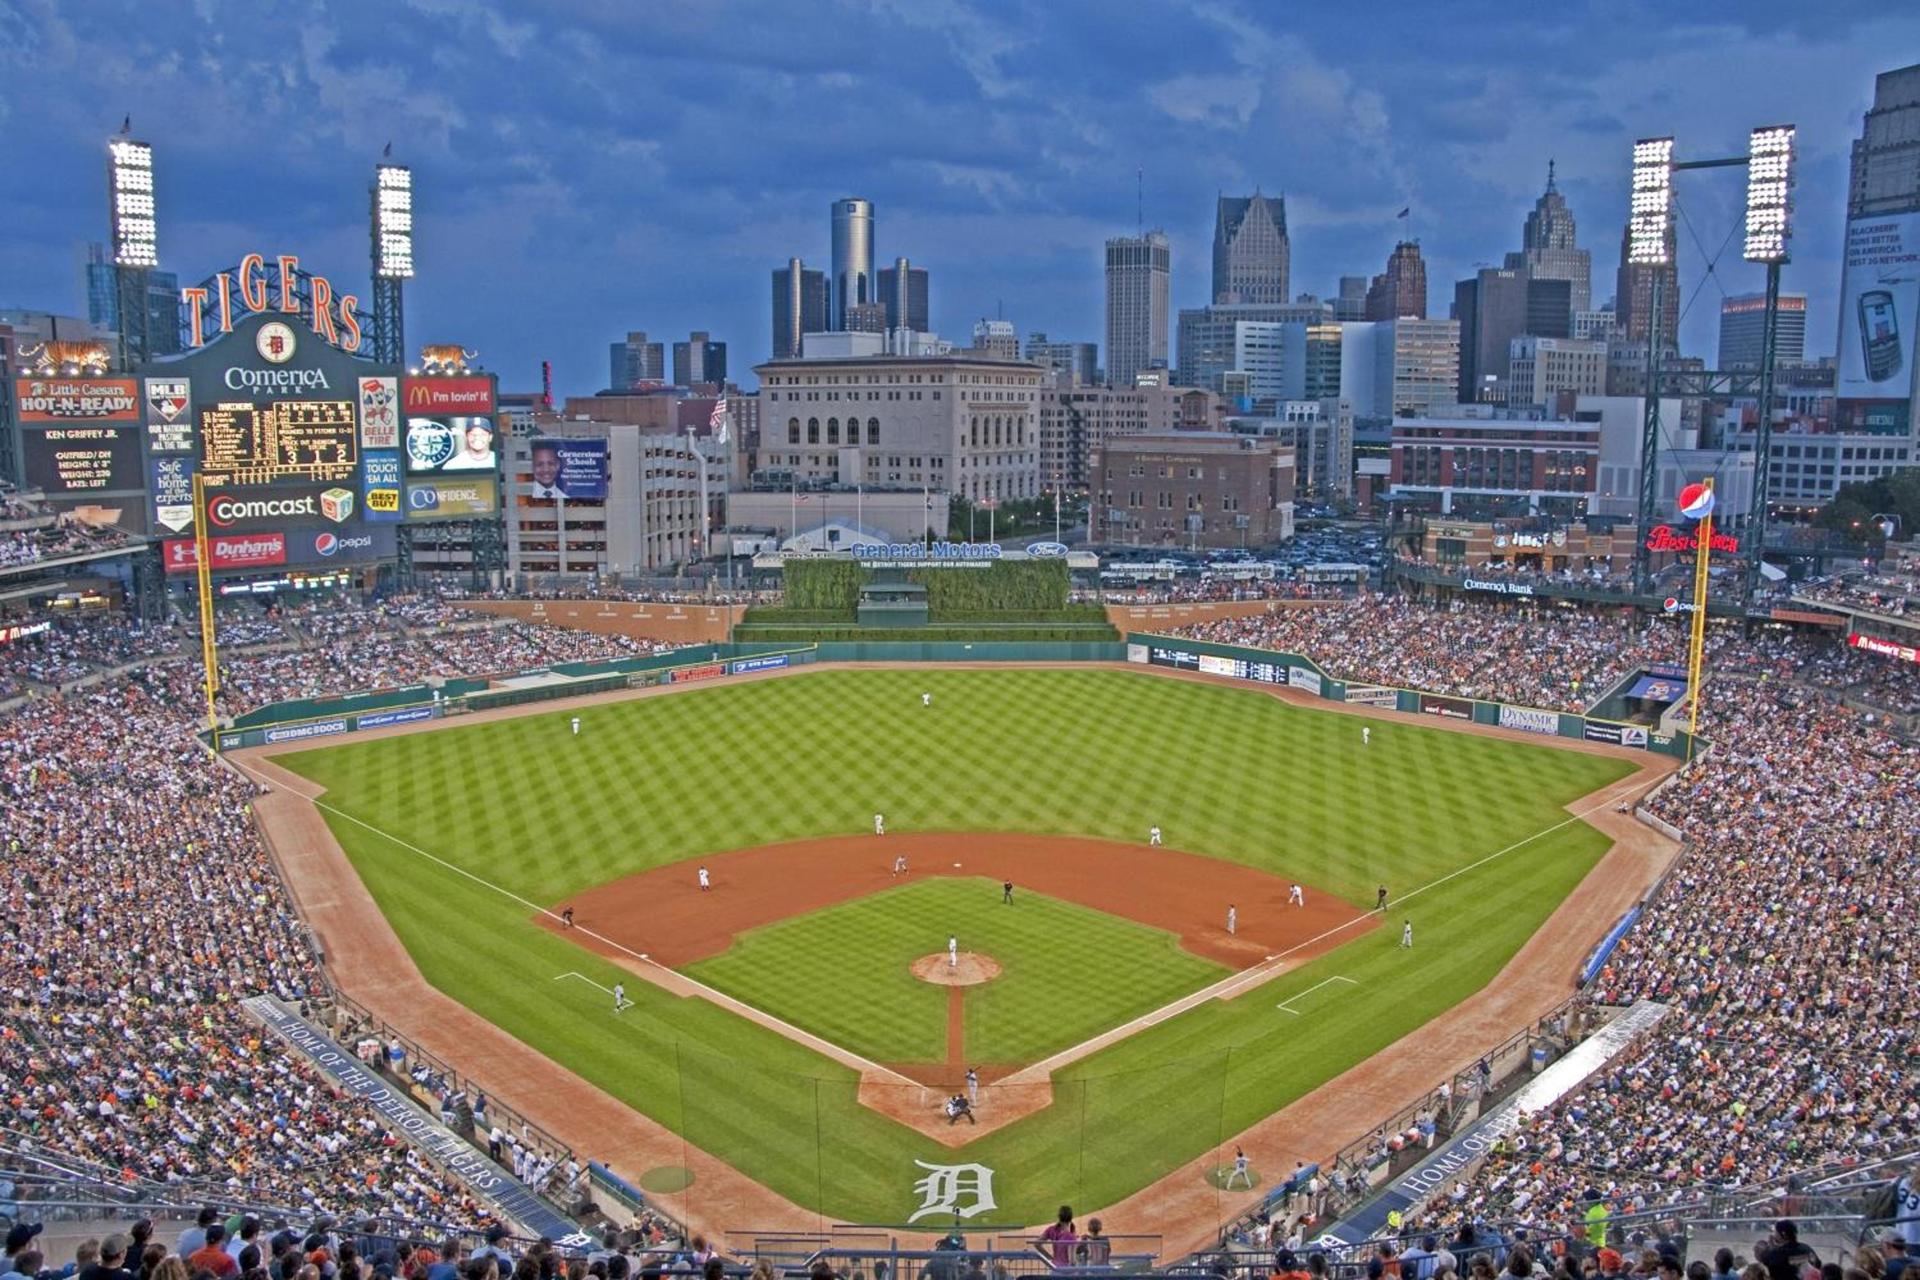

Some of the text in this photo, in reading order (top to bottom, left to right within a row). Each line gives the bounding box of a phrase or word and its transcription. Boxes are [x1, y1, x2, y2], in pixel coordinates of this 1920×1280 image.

[182, 253, 361, 351] TIGERS
[49, 383, 125, 396] Little Caesars
[150, 384, 186, 395] MLB
[253, 386, 302, 394] PARK
[433, 391, 489, 402] I'm lovin' it
[21, 397, 135, 411] HOT-N-READY
[46, 430, 118, 439] KEN GRIFFEY JR.
[364, 426, 395, 436] BELLE
[369, 436, 391, 445] TIRE
[288, 449, 346, 464] 3 1 2
[557, 449, 604, 458] Cornerstone
[158, 461, 182, 474] Safe
[367, 464, 397, 472] TOUCH
[566, 458, 597, 466] Schools
[158, 477, 189, 489] home
[382, 474, 397, 483] ALL
[156, 491, 193, 504] experts
[371, 492, 396, 501] BEST
[372, 500, 394, 508] BUY
[339, 536, 371, 550] pepsi
[1647, 526, 1689, 551] PEPSI
[216, 539, 282, 557] Dunham's
[851, 542, 1002, 559] General Motors
[1034, 546, 1060, 555] Ford
[1508, 583, 1533, 595] Bank
[1502, 707, 1555, 727] DYNAMIC
[320, 722, 344, 732] DOCS
[281, 1022, 502, 1189] HOME OF THE DETROIT TIGERS
[1402, 1150, 1468, 1194] HOME
